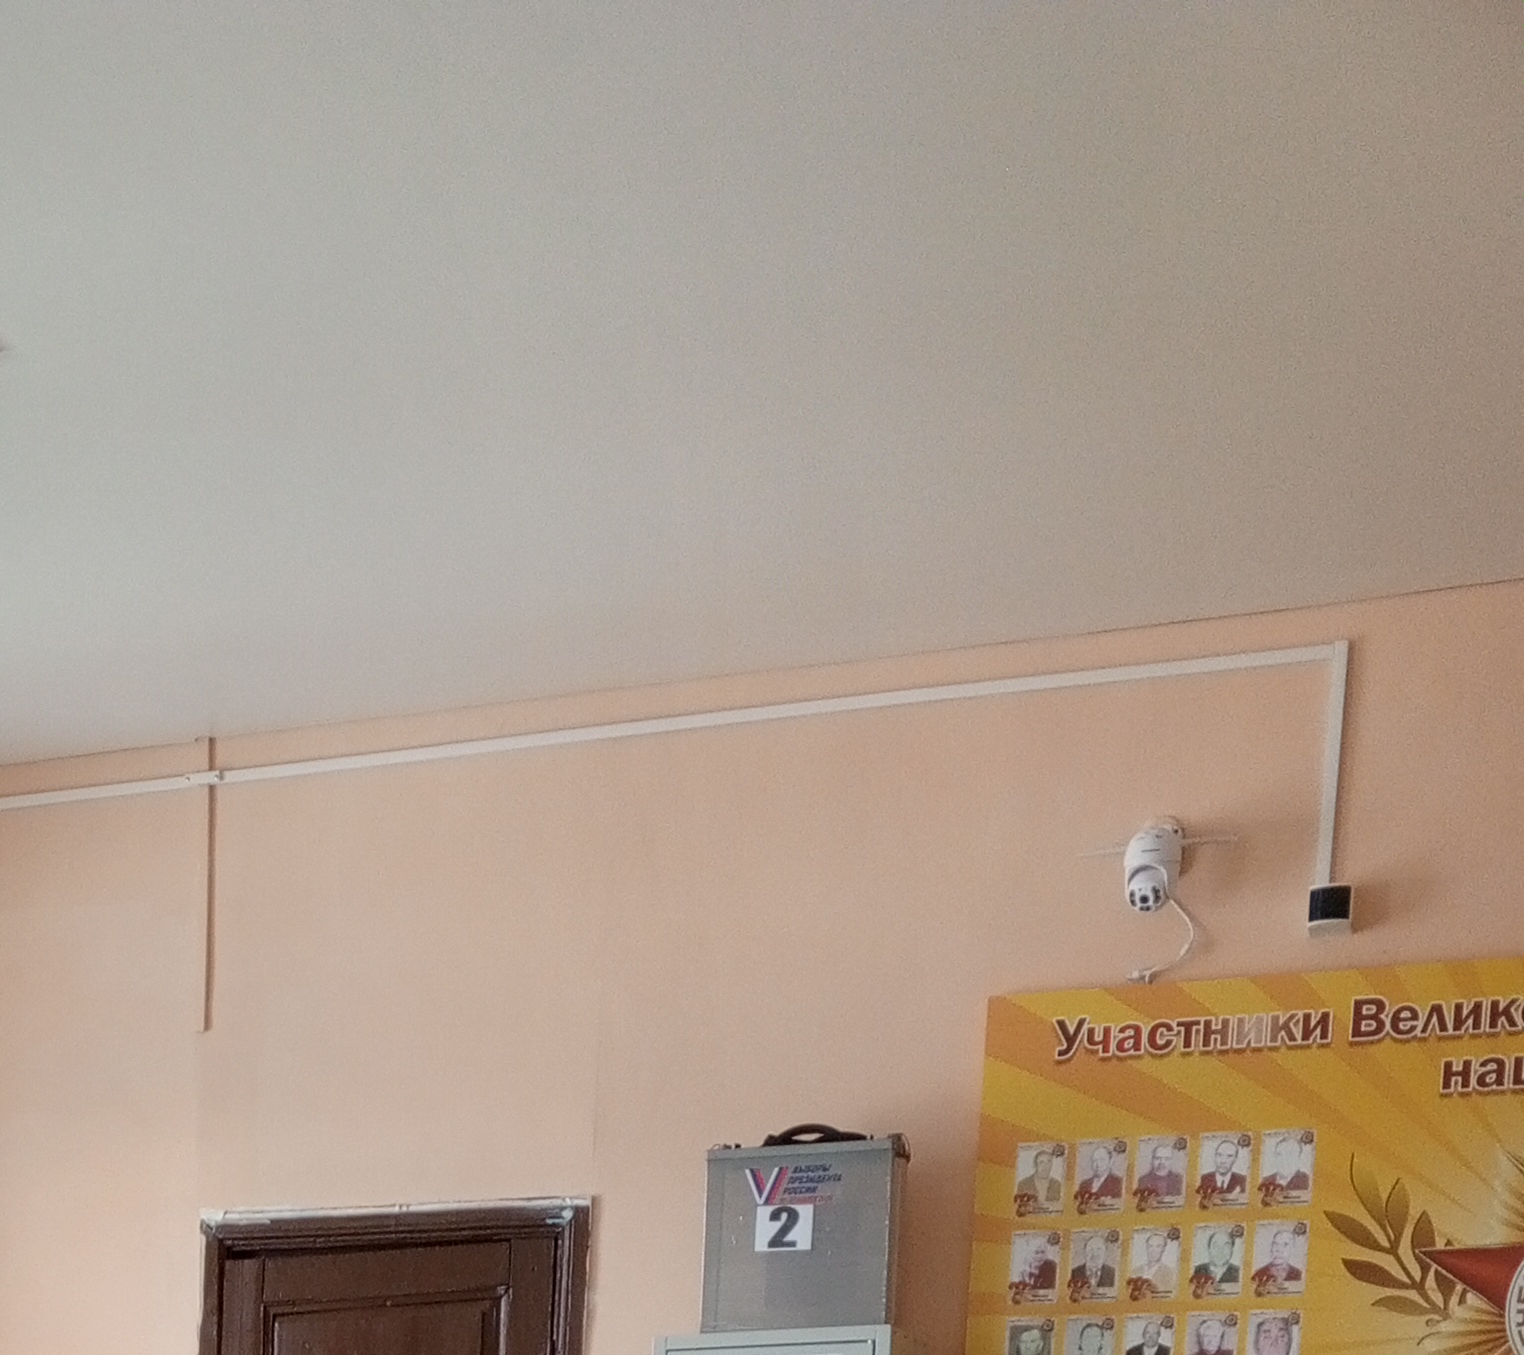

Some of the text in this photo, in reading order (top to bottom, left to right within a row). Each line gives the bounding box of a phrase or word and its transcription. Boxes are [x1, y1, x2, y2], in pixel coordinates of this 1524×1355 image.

[1055, 995, 1524, 1060] Участники Велик
[767, 1206, 800, 1248] 2
